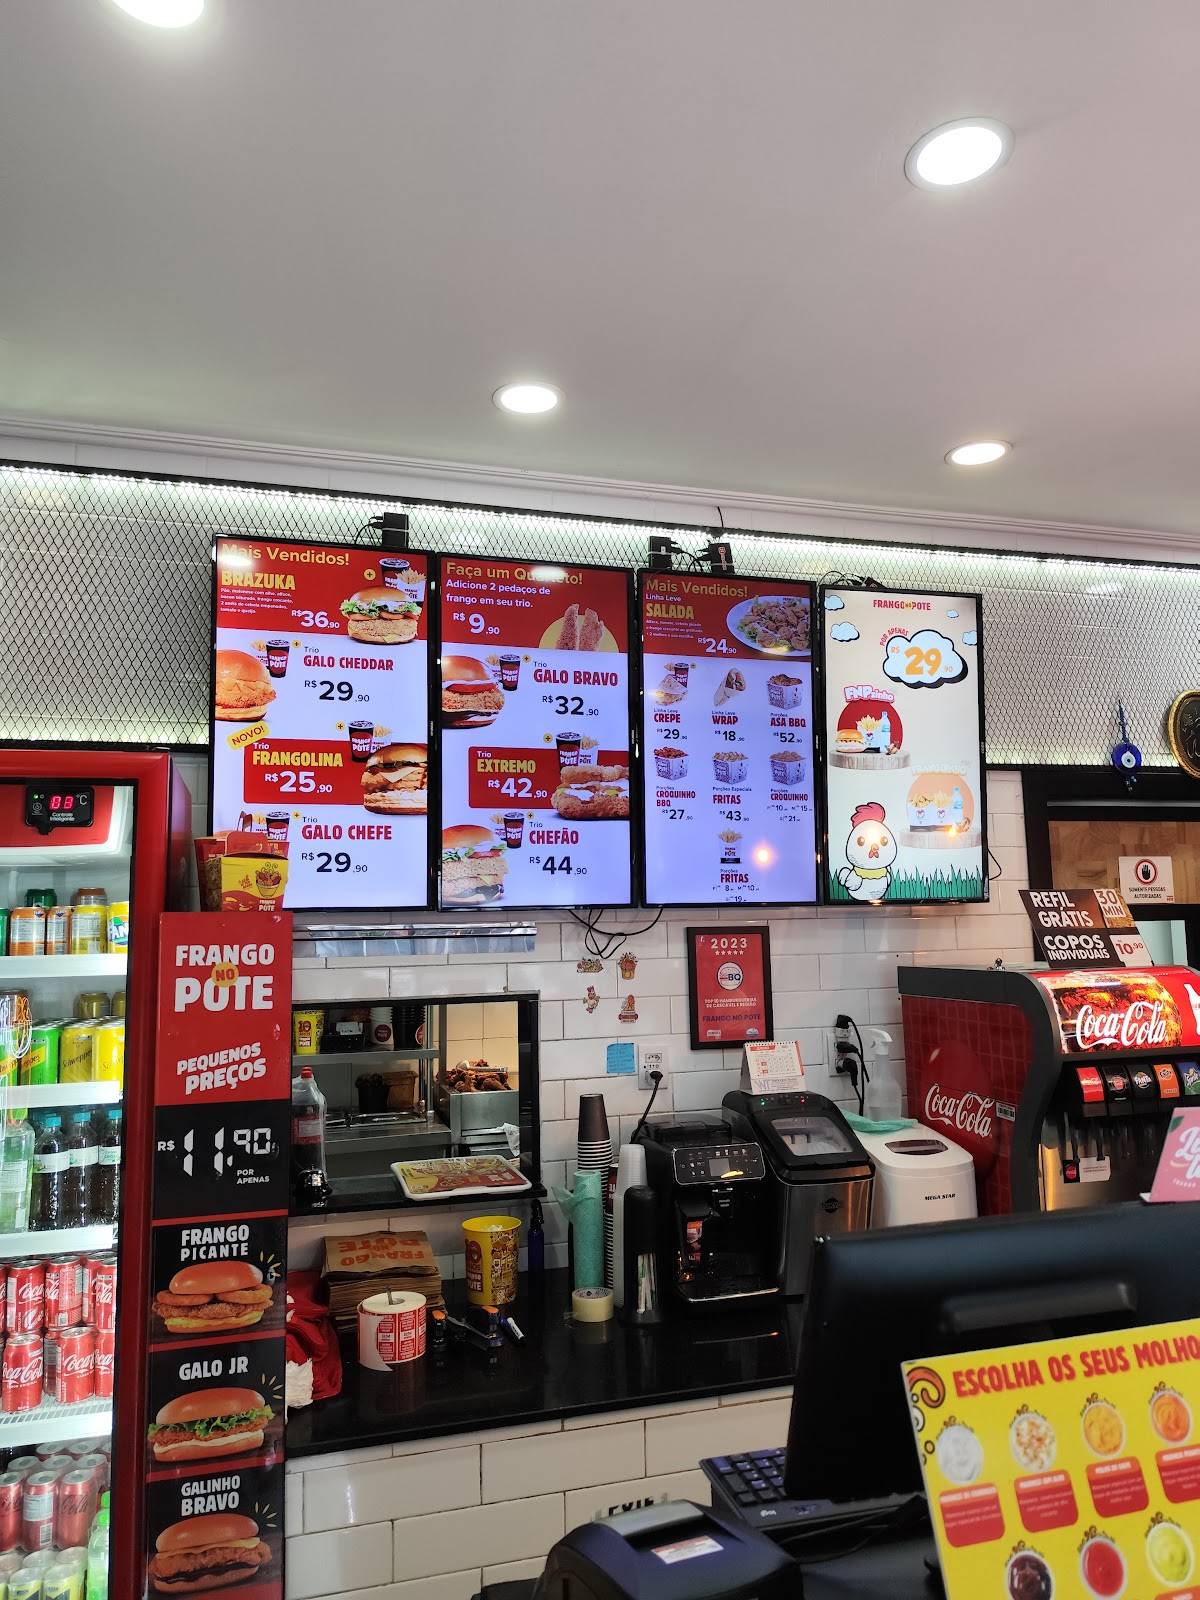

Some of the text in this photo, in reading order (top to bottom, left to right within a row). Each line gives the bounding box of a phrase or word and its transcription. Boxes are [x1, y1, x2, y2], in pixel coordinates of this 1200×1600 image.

[221, 544, 349, 565] Mais Vendidos!
[447, 563, 482, 578] Faça
[487, 569, 510, 579] um
[221, 572, 295, 590] BRAZUKA
[446, 580, 551, 595] Adicione 2 pedaços de
[646, 579, 748, 598] Mais Vendidos!
[446, 594, 533, 608] frango em seu trio.
[873, 600, 905, 609] FRANGO
[911, 602, 931, 611] POTE
[453, 613, 466, 622] R$
[646, 603, 695, 619] SALADA
[887, 627, 908, 637] APENAS
[304, 656, 394, 671] GALO CHEDDAR
[904, 647, 942, 676] 29
[304, 680, 317, 689] R$
[534, 669, 618, 687] GALO BRAVO
[542, 695, 554, 704] R$
[653, 713, 681, 724] CREPE
[712, 715, 738, 725] WRAP
[770, 717, 806, 728] ASA BBQ
[231, 725, 265, 745] NOVO!
[253, 751, 343, 767] FRANGOLINA
[477, 760, 536, 774] EXTREMO
[264, 773, 278, 783] R$
[488, 780, 500, 789] R$
[656, 790, 696, 799] CROQUINHO
[712, 795, 741, 804] FRITAS
[302, 824, 392, 841] GALO CHEFE
[529, 827, 579, 845] CHEFÃO
[301, 853, 315, 861] R$
[529, 856, 541, 864] R$
[720, 874, 749, 883] FRITAS
[1029, 891, 1076, 908] REFIL
[1098, 891, 1118, 905] 30
[1038, 907, 1094, 928] GRÁTIS
[1103, 905, 1124, 917] MIN
[711, 938, 748, 949] 2023
[1044, 934, 1105, 950] COPOS
[175, 943, 275, 967] FRANGO
[1047, 948, 1110, 961] INDIVIDUAIS
[215, 968, 236, 982] NO
[174, 975, 274, 1013] POTE
[1075, 1000, 1168, 1050] Coca-Cola
[177, 1042, 262, 1076] PEQUENOS
[185, 1058, 267, 1095] PREÇOS
[924, 1083, 993, 1138] Coca-Cola
[157, 1139, 175, 1152] R$
[236, 1169, 255, 1177] POR
[236, 1176, 270, 1185] APENAS
[181, 1224, 250, 1247] FRANGO
[180, 1243, 249, 1262] PICANTE
[179, 1356, 249, 1381] GALO JR
[953, 1359, 1044, 1398] ESCOLHA
[1048, 1354, 1076, 1382] OS
[1080, 1345, 1131, 1378] SEUS
[181, 1475, 241, 1497] GALINHO
[181, 1491, 240, 1516] BRAVO
